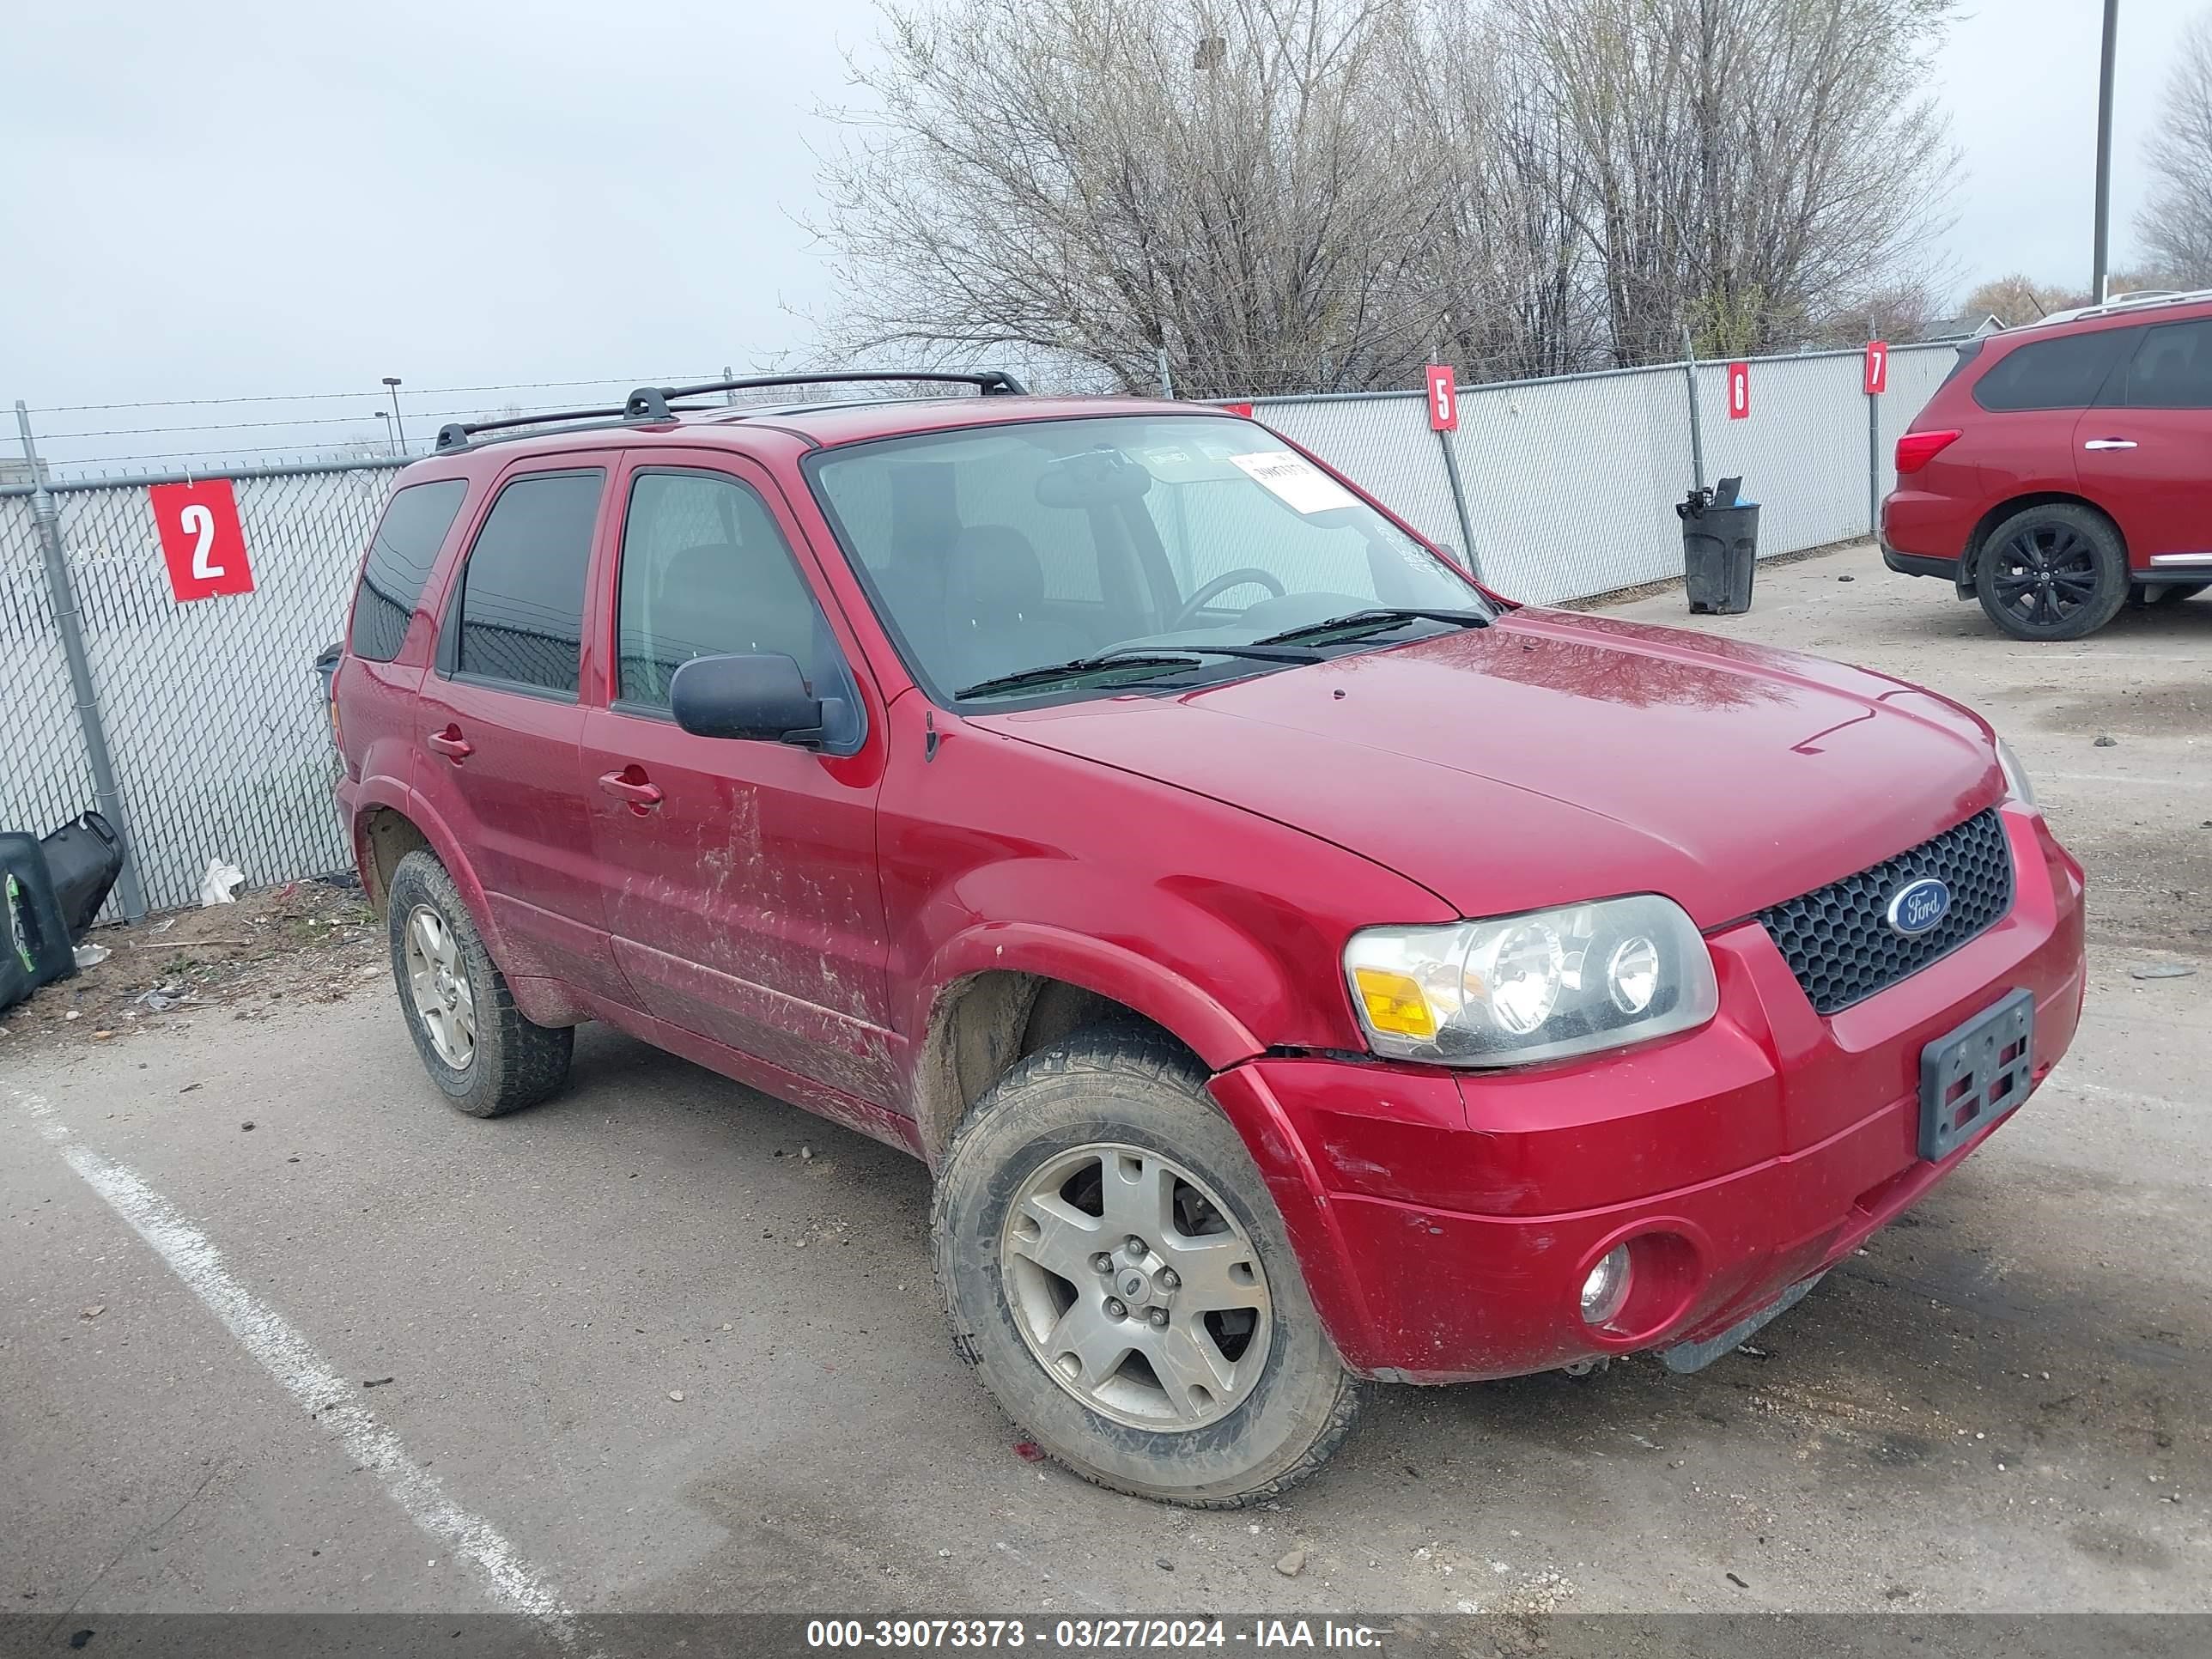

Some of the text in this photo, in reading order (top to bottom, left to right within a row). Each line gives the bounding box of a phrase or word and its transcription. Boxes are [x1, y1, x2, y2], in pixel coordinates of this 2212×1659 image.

[1872, 352, 1882, 385] 7
[1435, 379, 1450, 421] 5
[1735, 374, 1744, 411] 6
[180, 504, 226, 580] 2
[1907, 890, 1941, 925] Ford
